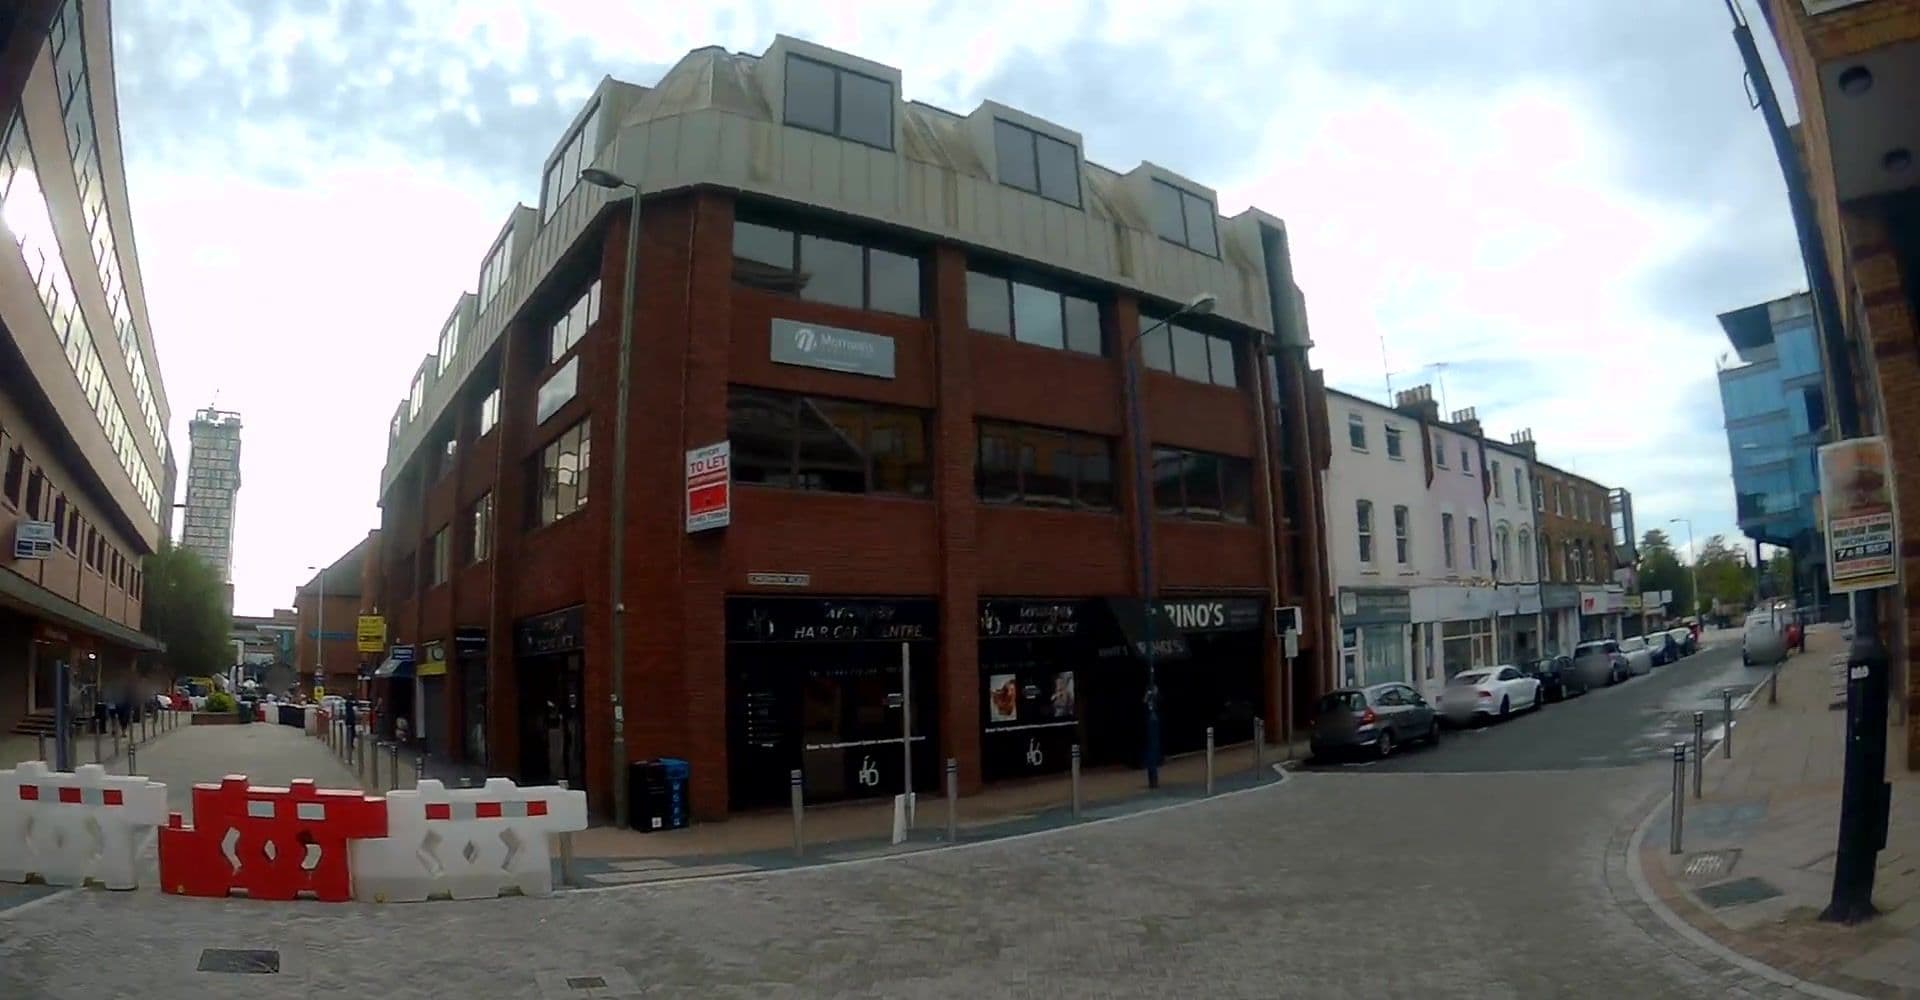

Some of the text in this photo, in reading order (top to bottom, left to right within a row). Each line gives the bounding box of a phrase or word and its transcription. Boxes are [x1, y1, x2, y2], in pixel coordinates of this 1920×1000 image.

[690, 454, 727, 474] TO LET
[793, 626, 828, 639] HAR
